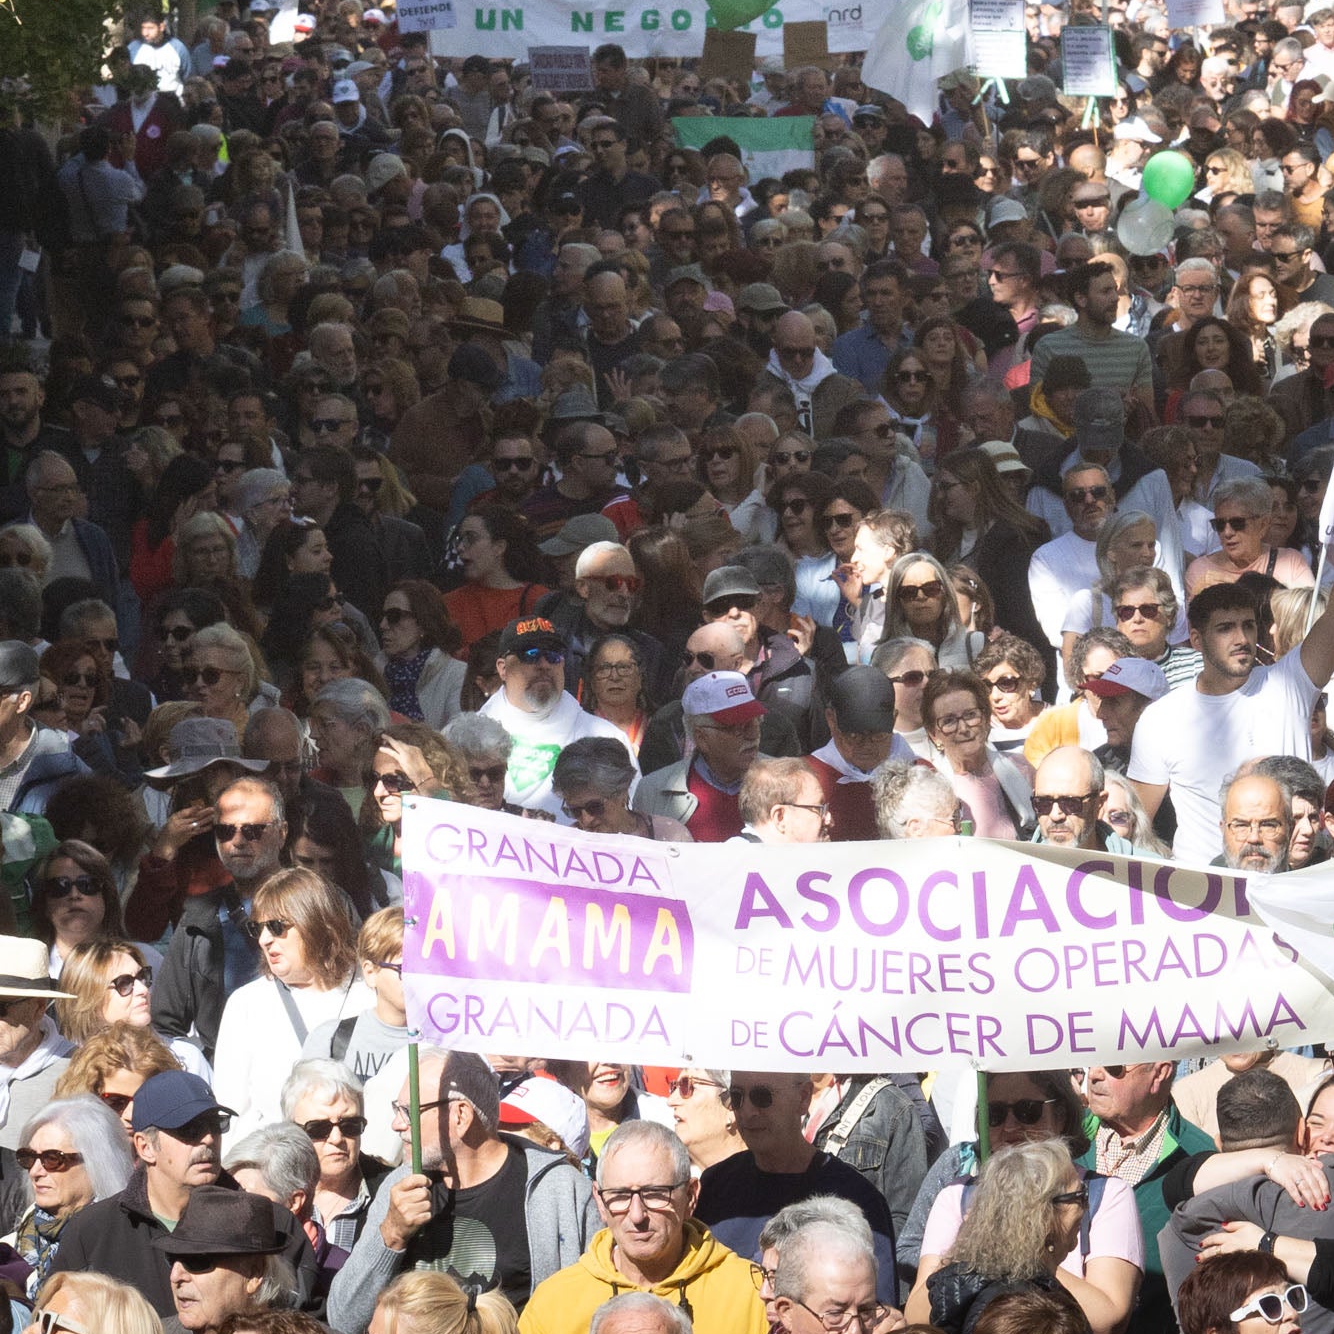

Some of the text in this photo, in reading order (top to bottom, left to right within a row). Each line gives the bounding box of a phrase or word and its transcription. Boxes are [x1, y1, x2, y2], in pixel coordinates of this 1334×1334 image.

[399, 2, 452, 18] DEFIENDE
[475, 8, 784, 32] UN NEGOO
[424, 823, 662, 890] GRANADA
[421, 886, 684, 977] AMAMA
[736, 927, 1299, 995] DE MUJERES OPERADAS
[426, 992, 672, 1047] GRANADA
[731, 992, 1306, 1058] DE CÁNCER DE MAMA
